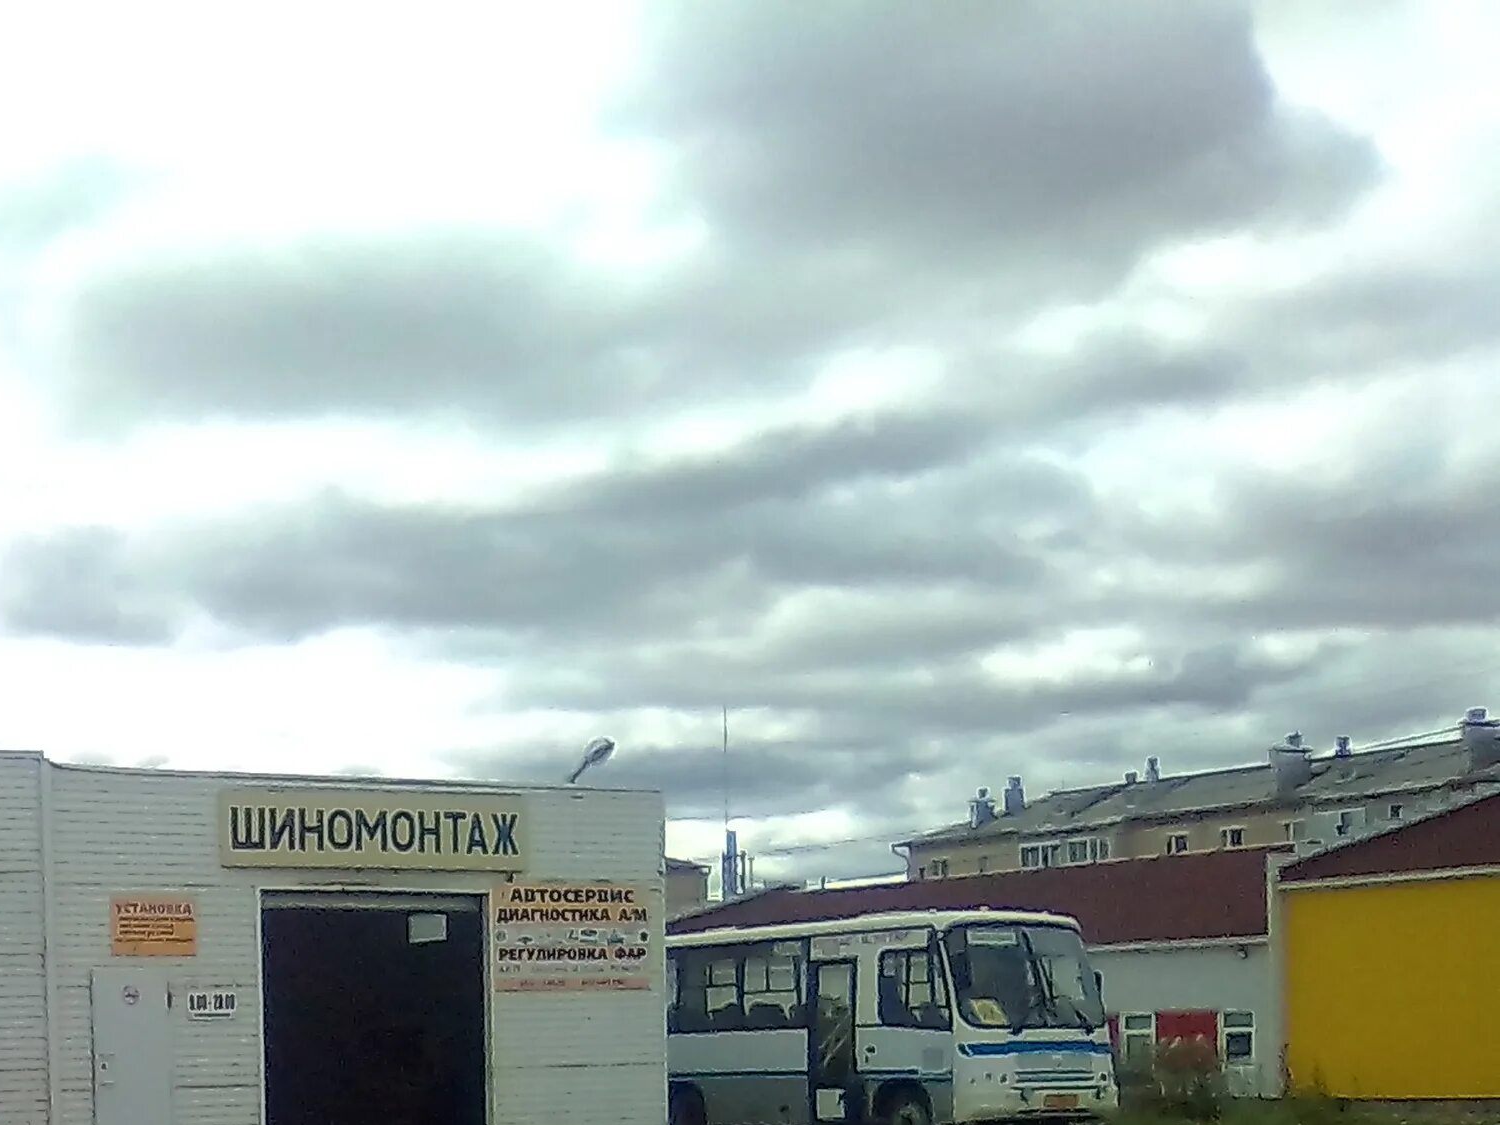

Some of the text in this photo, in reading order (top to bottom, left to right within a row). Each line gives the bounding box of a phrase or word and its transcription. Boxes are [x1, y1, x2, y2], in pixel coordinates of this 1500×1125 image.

[229, 806, 520, 856] ШИНОМОНТАЖ
[510, 888, 635, 903] АВТОСЕРВИС
[115, 903, 193, 916] УСТАНОВКА
[497, 908, 611, 923] ДИАГНОСТИКА
[498, 946, 648, 961] РЕГУЛИРОВКА ФАР
